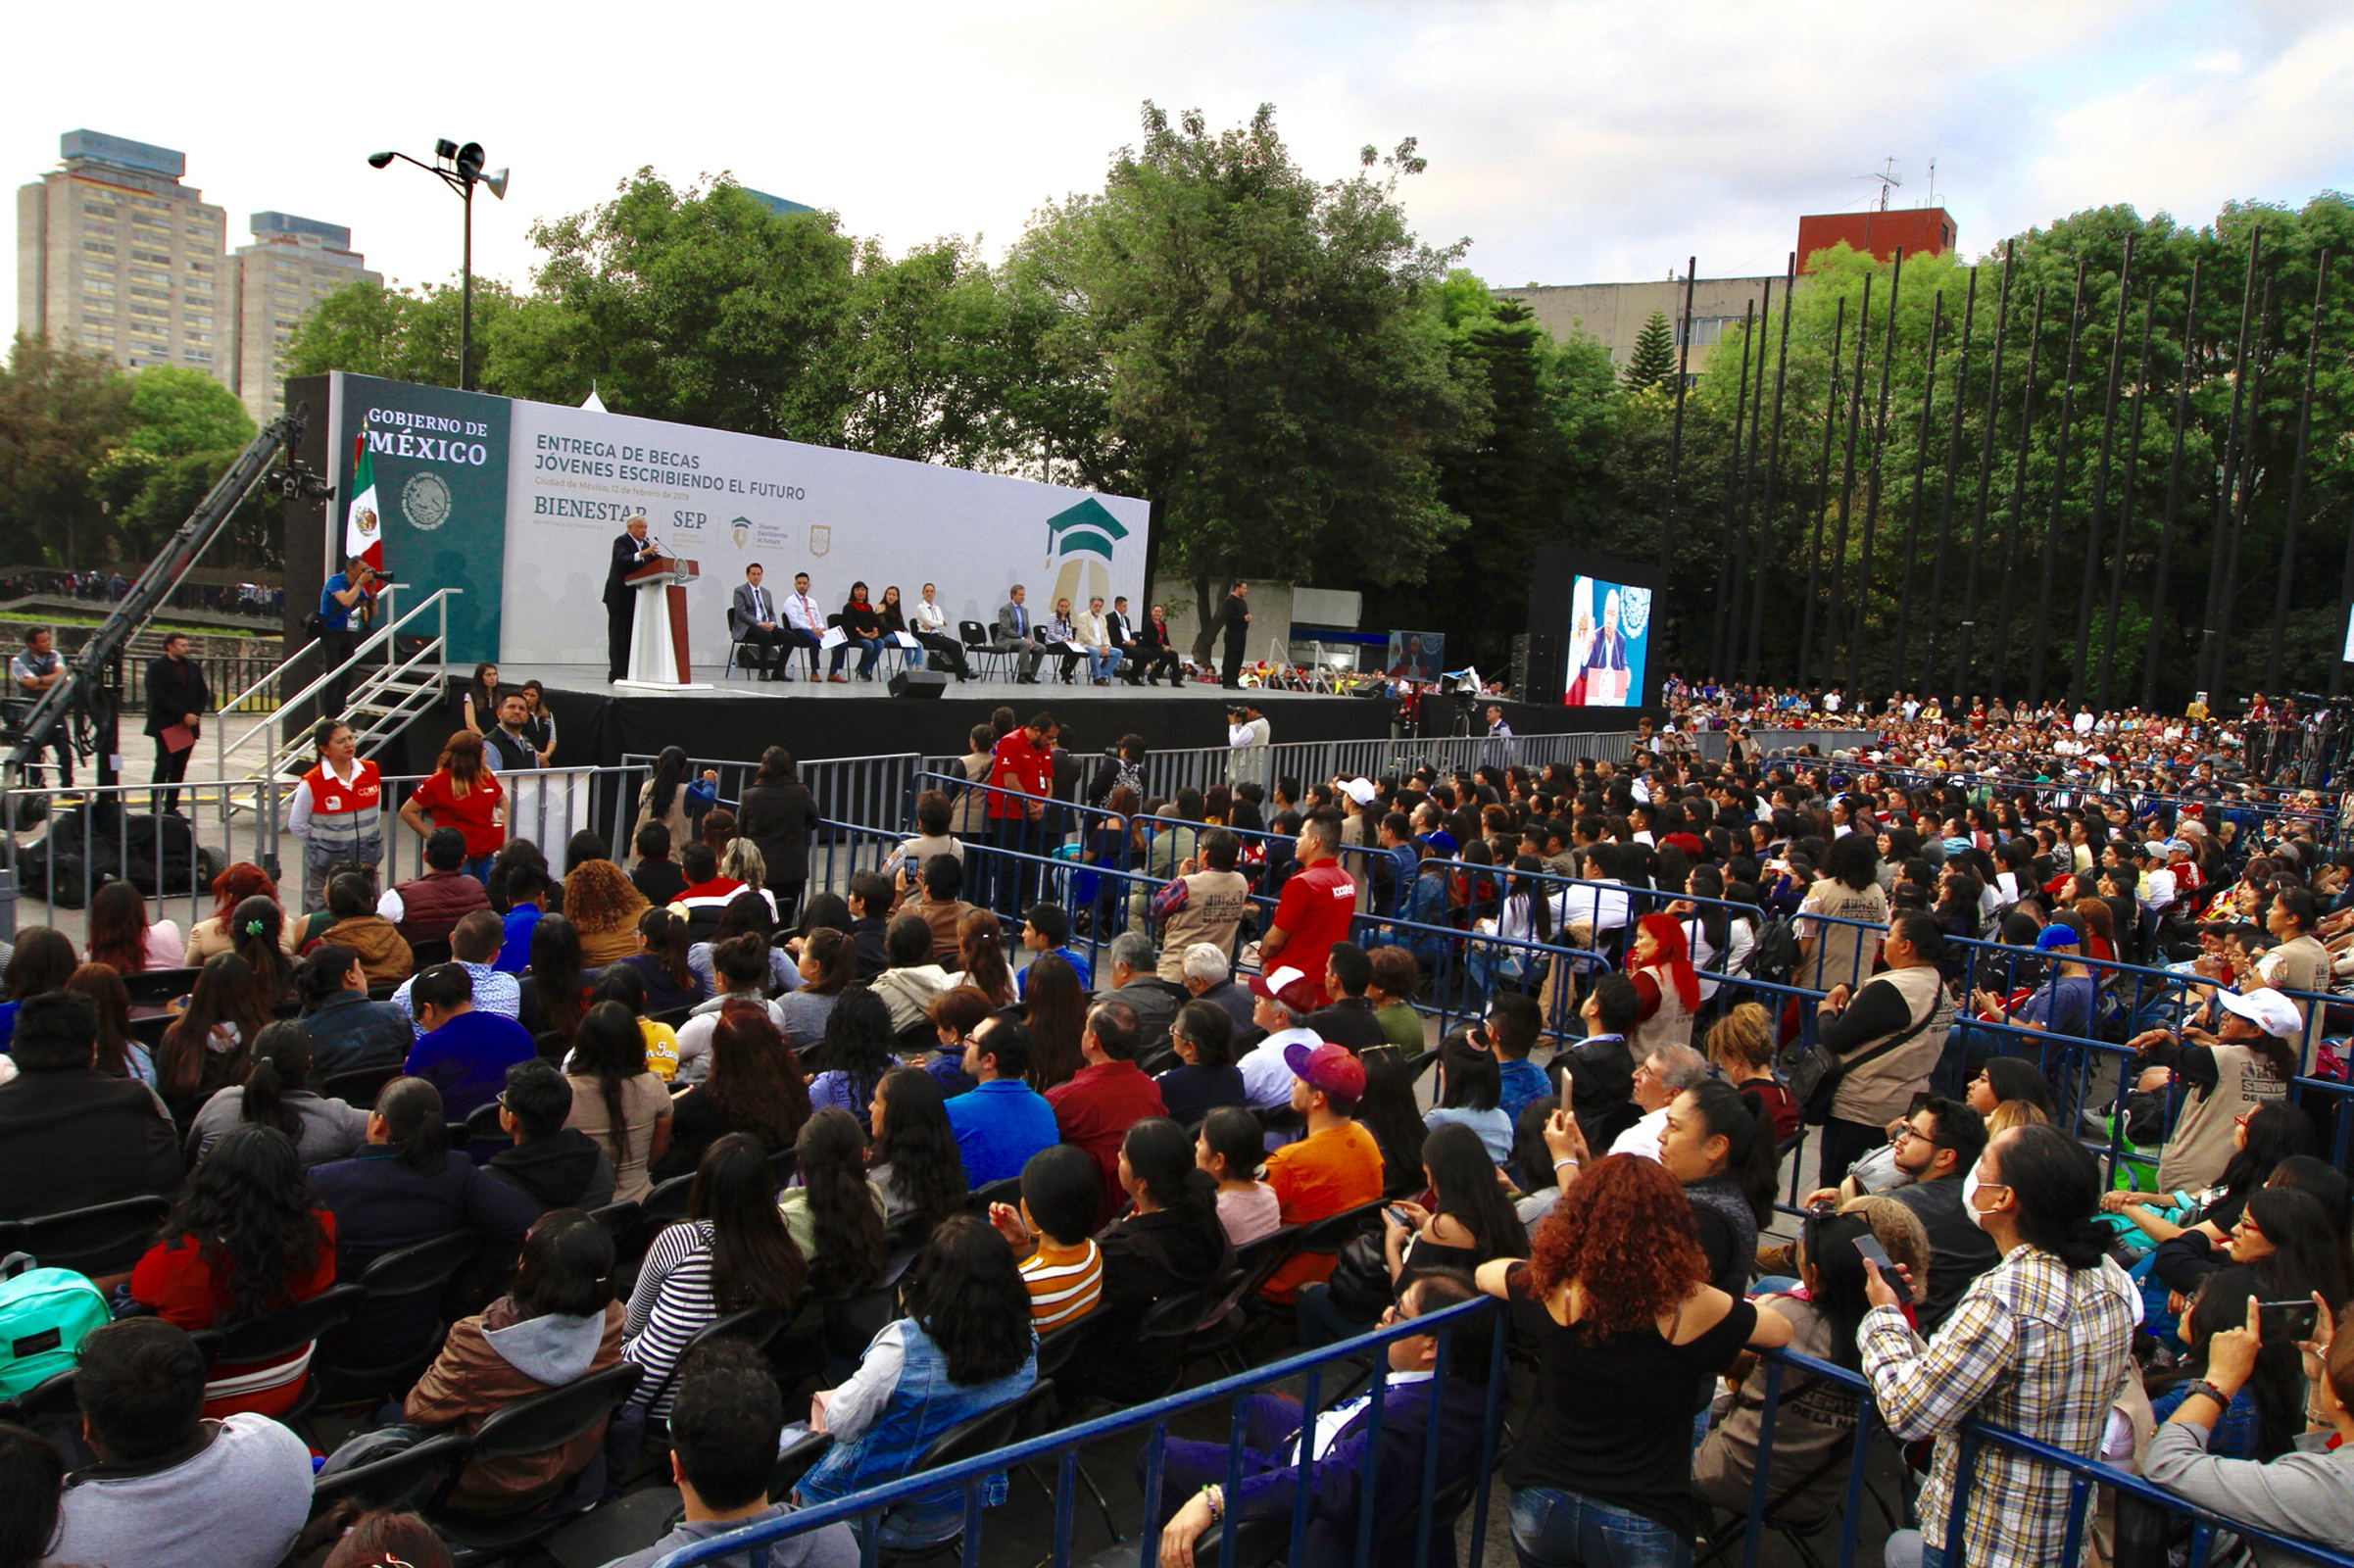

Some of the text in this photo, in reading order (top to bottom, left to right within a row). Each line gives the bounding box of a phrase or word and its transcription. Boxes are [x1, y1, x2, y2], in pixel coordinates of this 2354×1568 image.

[368, 408, 488, 437] GOBIERNO DE
[368, 427, 487, 466] MÉXICO
[536, 433, 700, 469] ENTREGA DE BECAS
[534, 452, 806, 501] JÓVENES ESCRIBIENDO EL FUTURO
[535, 475, 564, 487] Ciudad
[566, 479, 577, 489] de
[611, 484, 618, 493] 12
[620, 485, 631, 494] de
[632, 486, 661, 498] febrero
[662, 490, 671, 499] de
[673, 492, 690, 501] 2019
[673, 510, 708, 530] SEP
